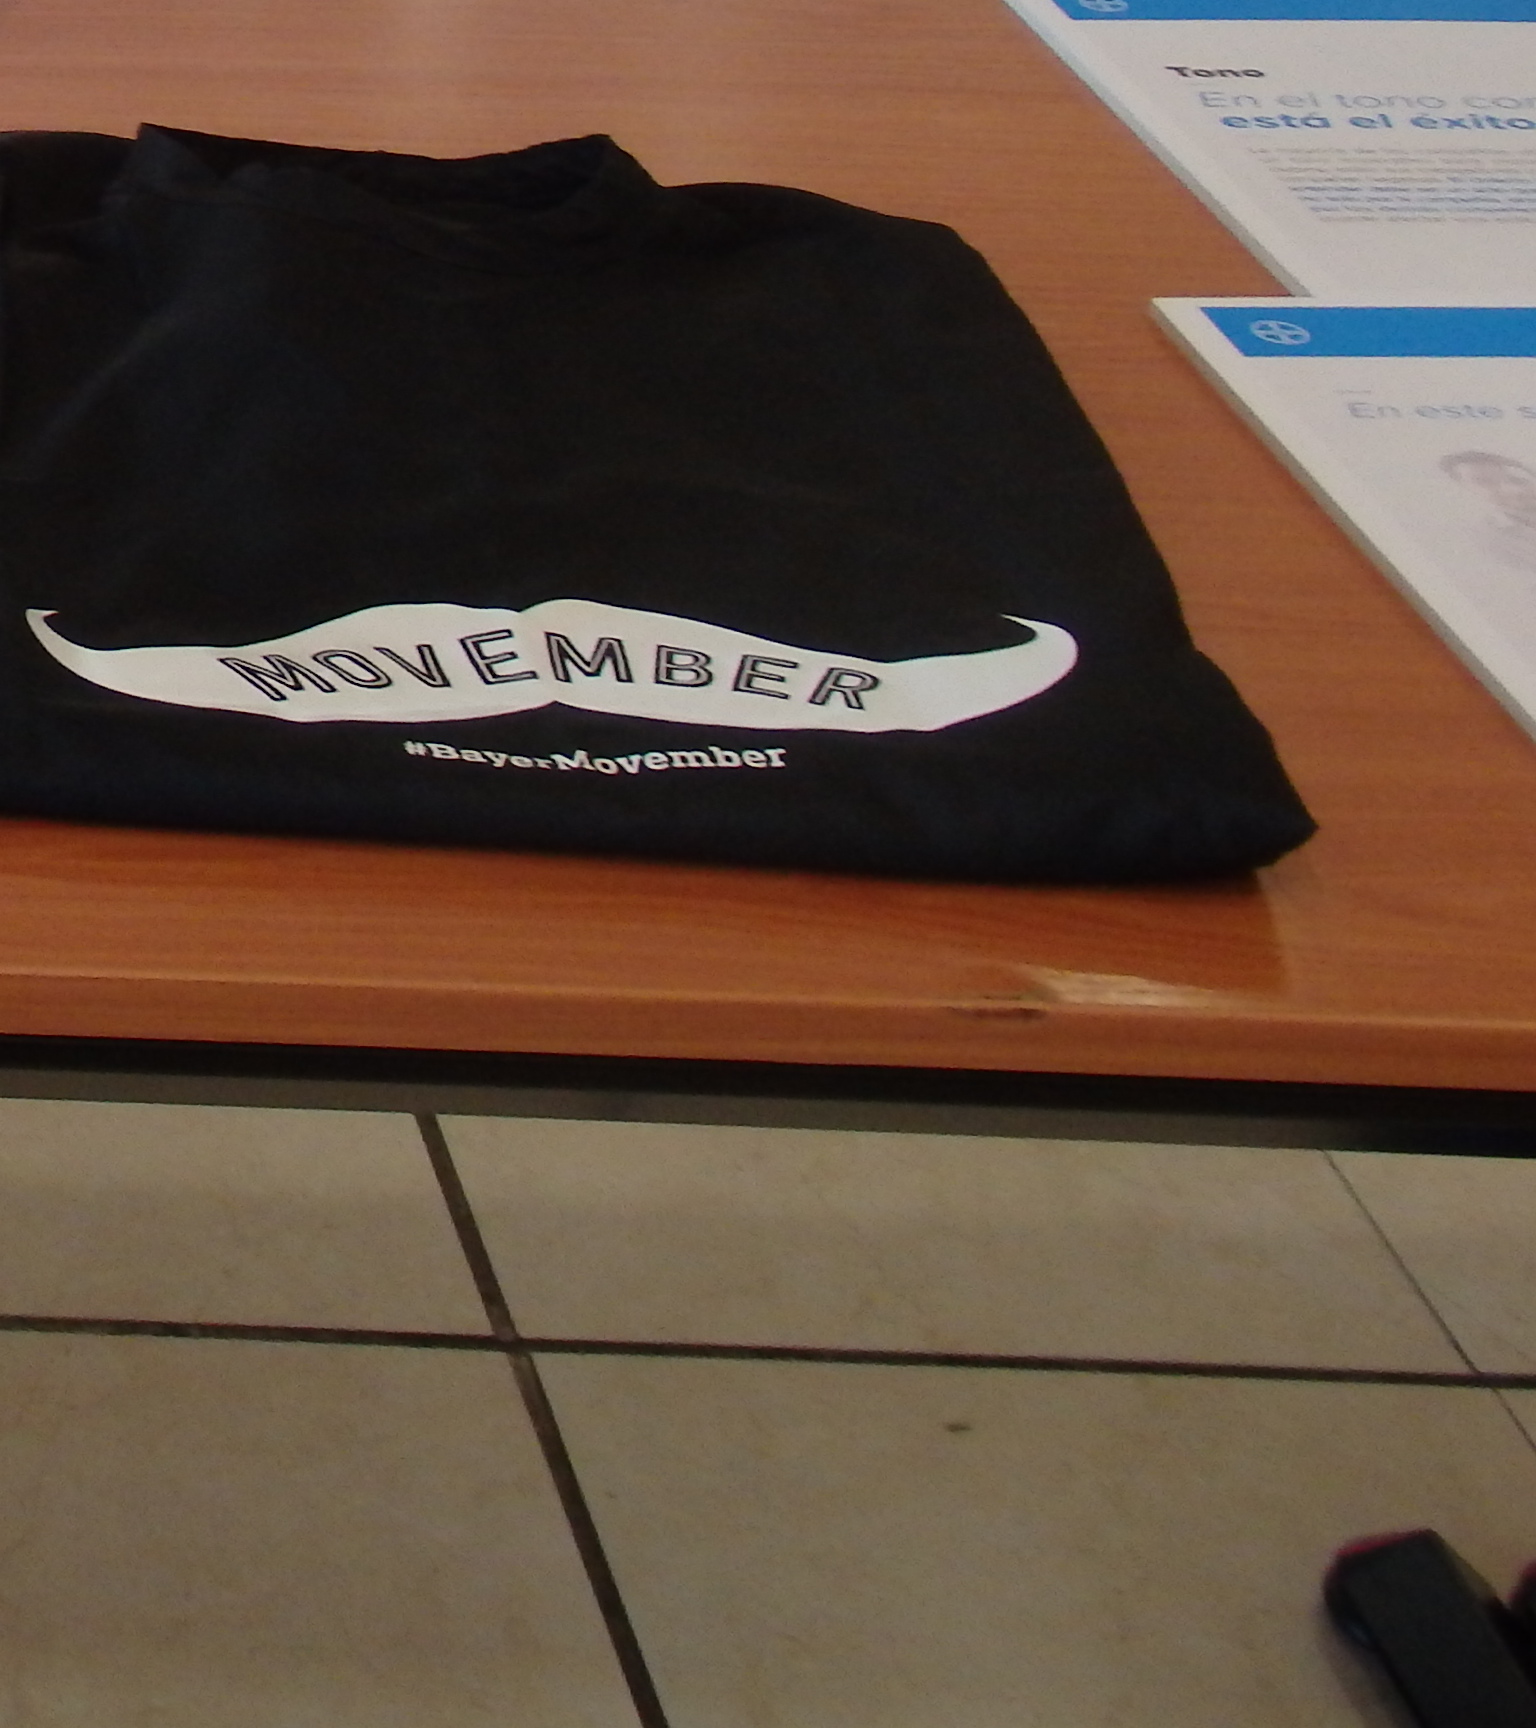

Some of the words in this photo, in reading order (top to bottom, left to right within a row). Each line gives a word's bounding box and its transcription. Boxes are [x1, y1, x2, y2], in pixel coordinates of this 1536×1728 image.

[1164, 65, 1265, 78] Tono
[1198, 91, 1262, 109] En
[1278, 91, 1322, 109] el
[1335, 93, 1447, 110] tono
[1220, 111, 1333, 130] está
[1348, 112, 1394, 130] el
[1409, 111, 1536, 131] éxito
[218, 627, 882, 712] MOVEMBER
[402, 737, 789, 777] #BayerMovember
